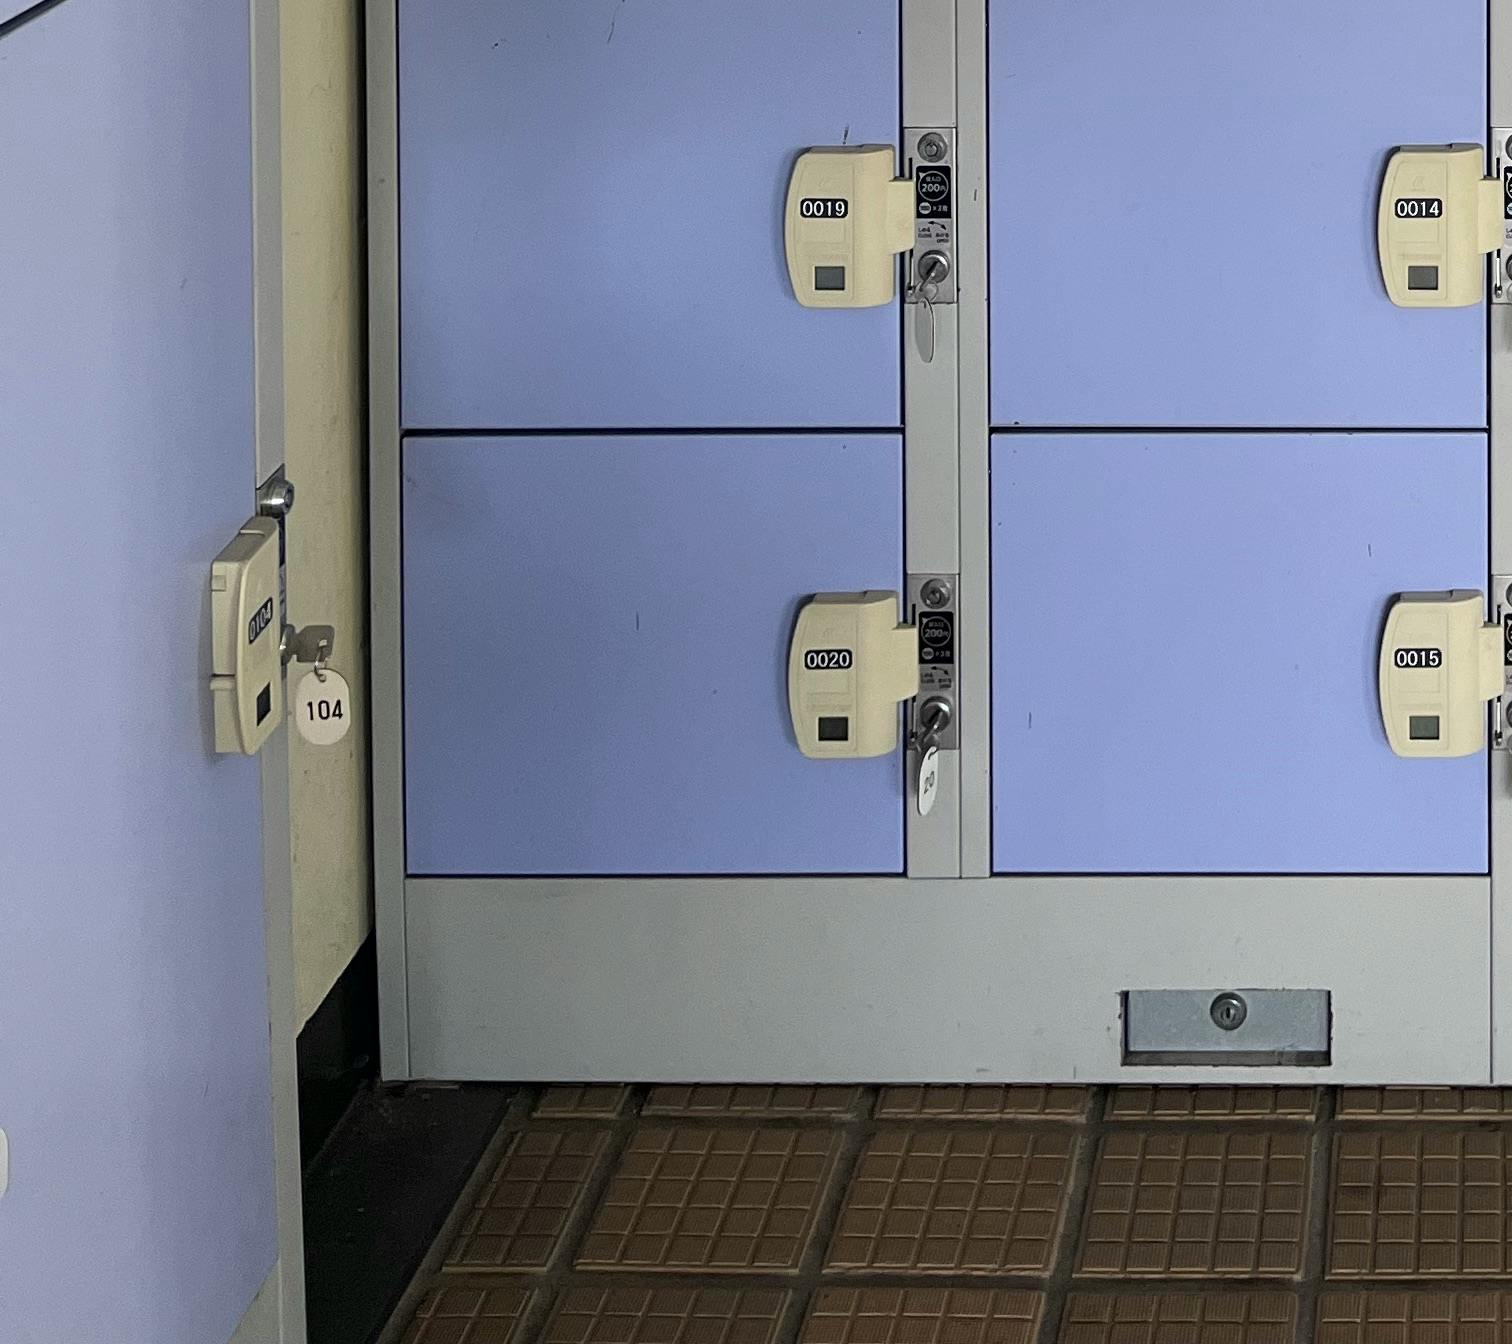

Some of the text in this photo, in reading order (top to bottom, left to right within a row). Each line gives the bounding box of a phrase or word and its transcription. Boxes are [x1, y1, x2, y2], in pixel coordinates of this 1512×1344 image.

[802, 200, 845, 216] 0019
[1396, 200, 1439, 217] 0014
[807, 652, 849, 668] 0020
[1396, 651, 1439, 667] 0015
[307, 699, 344, 722] 104
